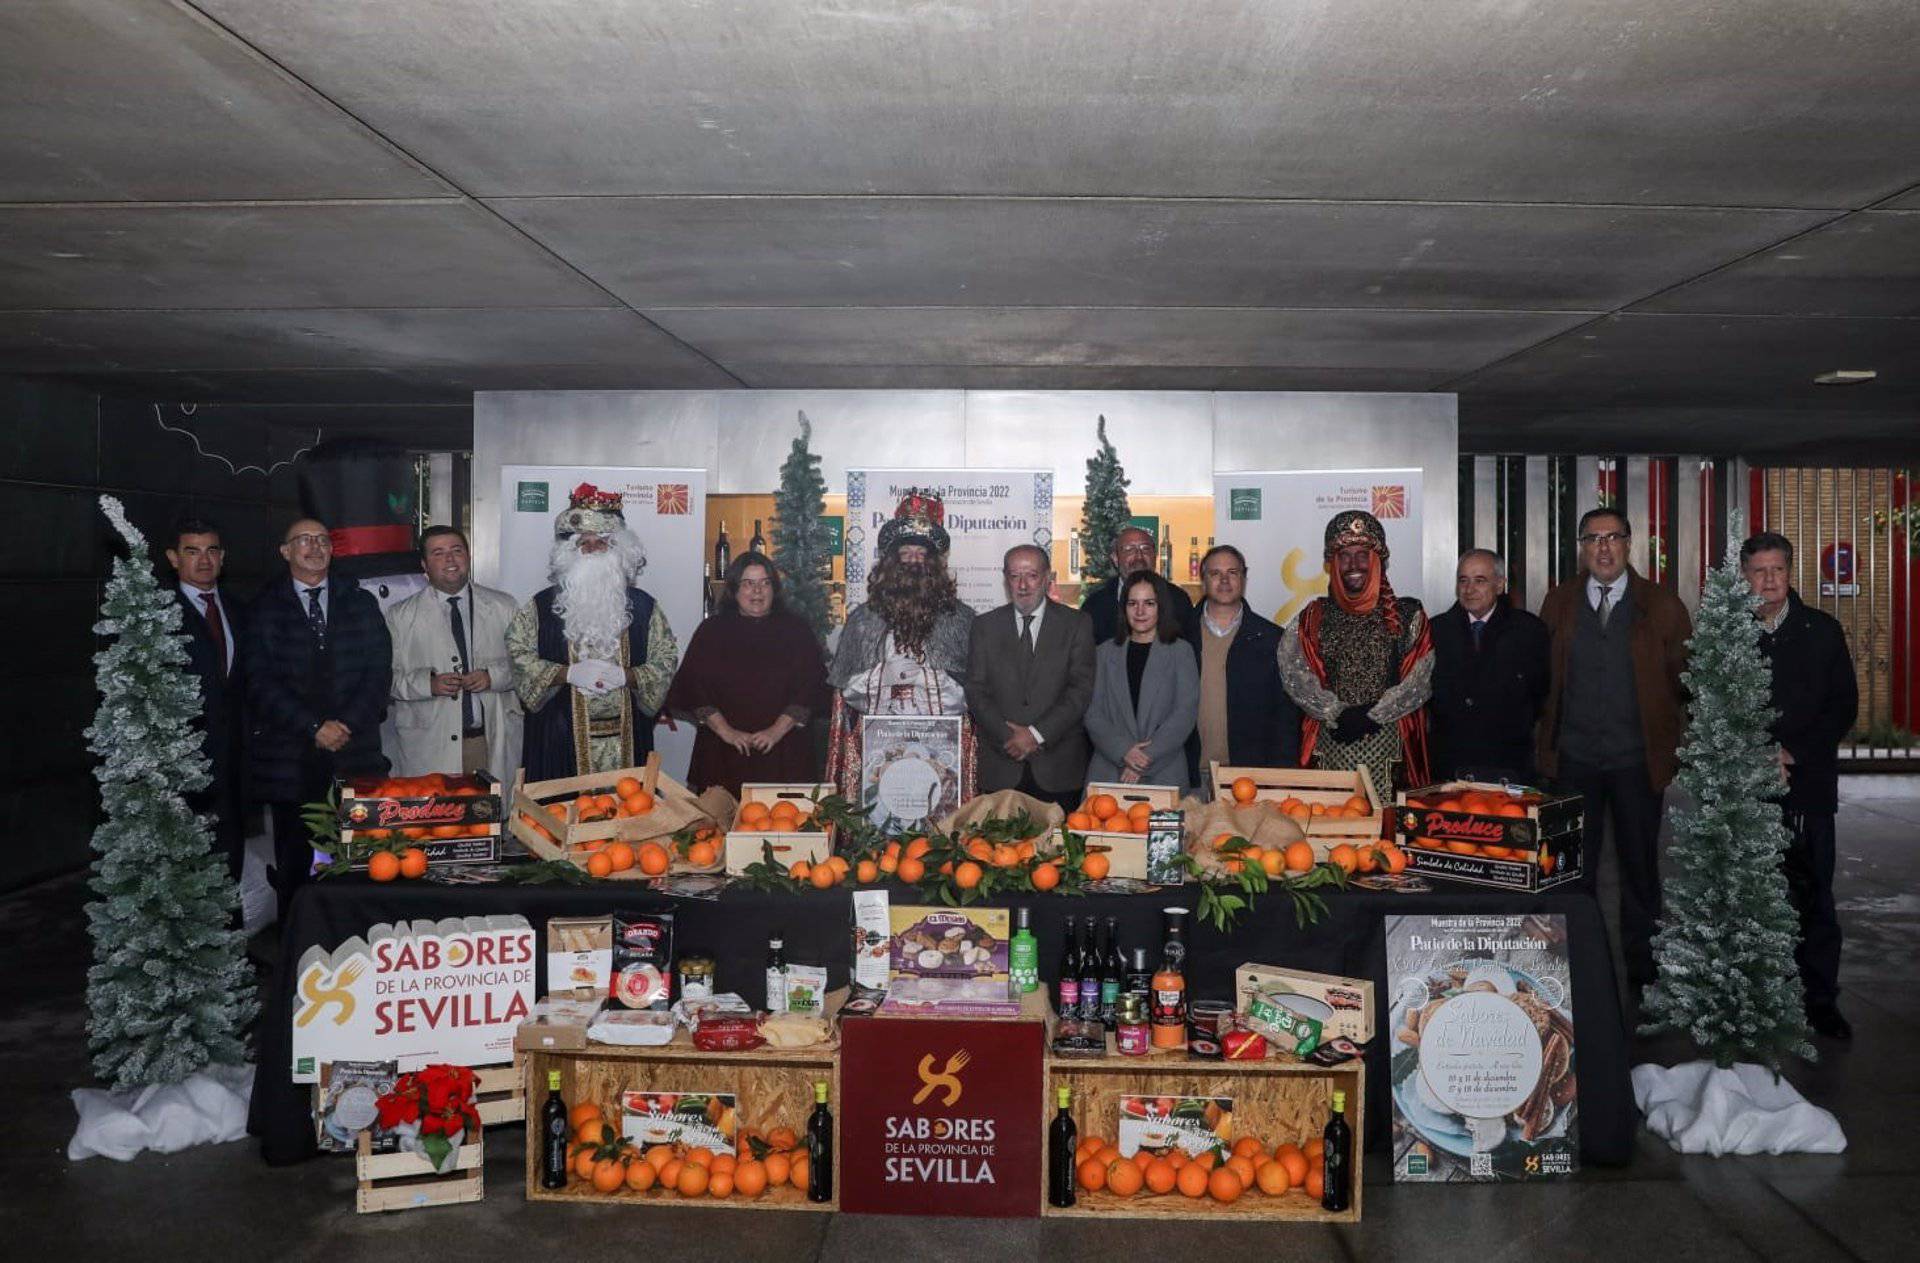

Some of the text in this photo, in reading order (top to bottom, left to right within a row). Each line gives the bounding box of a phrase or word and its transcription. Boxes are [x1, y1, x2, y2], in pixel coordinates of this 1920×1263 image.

[948, 485, 988, 497] Provincia
[989, 485, 1010, 498] 2022
[948, 512, 1027, 533] Diputación
[378, 797, 467, 826] Produce
[1425, 812, 1504, 838] Produce
[376, 934, 531, 973] SABORES
[1410, 936, 1547, 953] Patio de la Diputación
[376, 969, 532, 995] DE LA PROVINCIA DE
[375, 990, 529, 1035] SEVILLA
[649, 1110, 703, 1122] Sabores
[885, 1116, 996, 1141] SABORES
[1146, 1113, 1200, 1126] Sabores
[885, 1143, 995, 1156] DE LA PROVINCIA DE
[885, 1157, 996, 1184] SEVILLA
